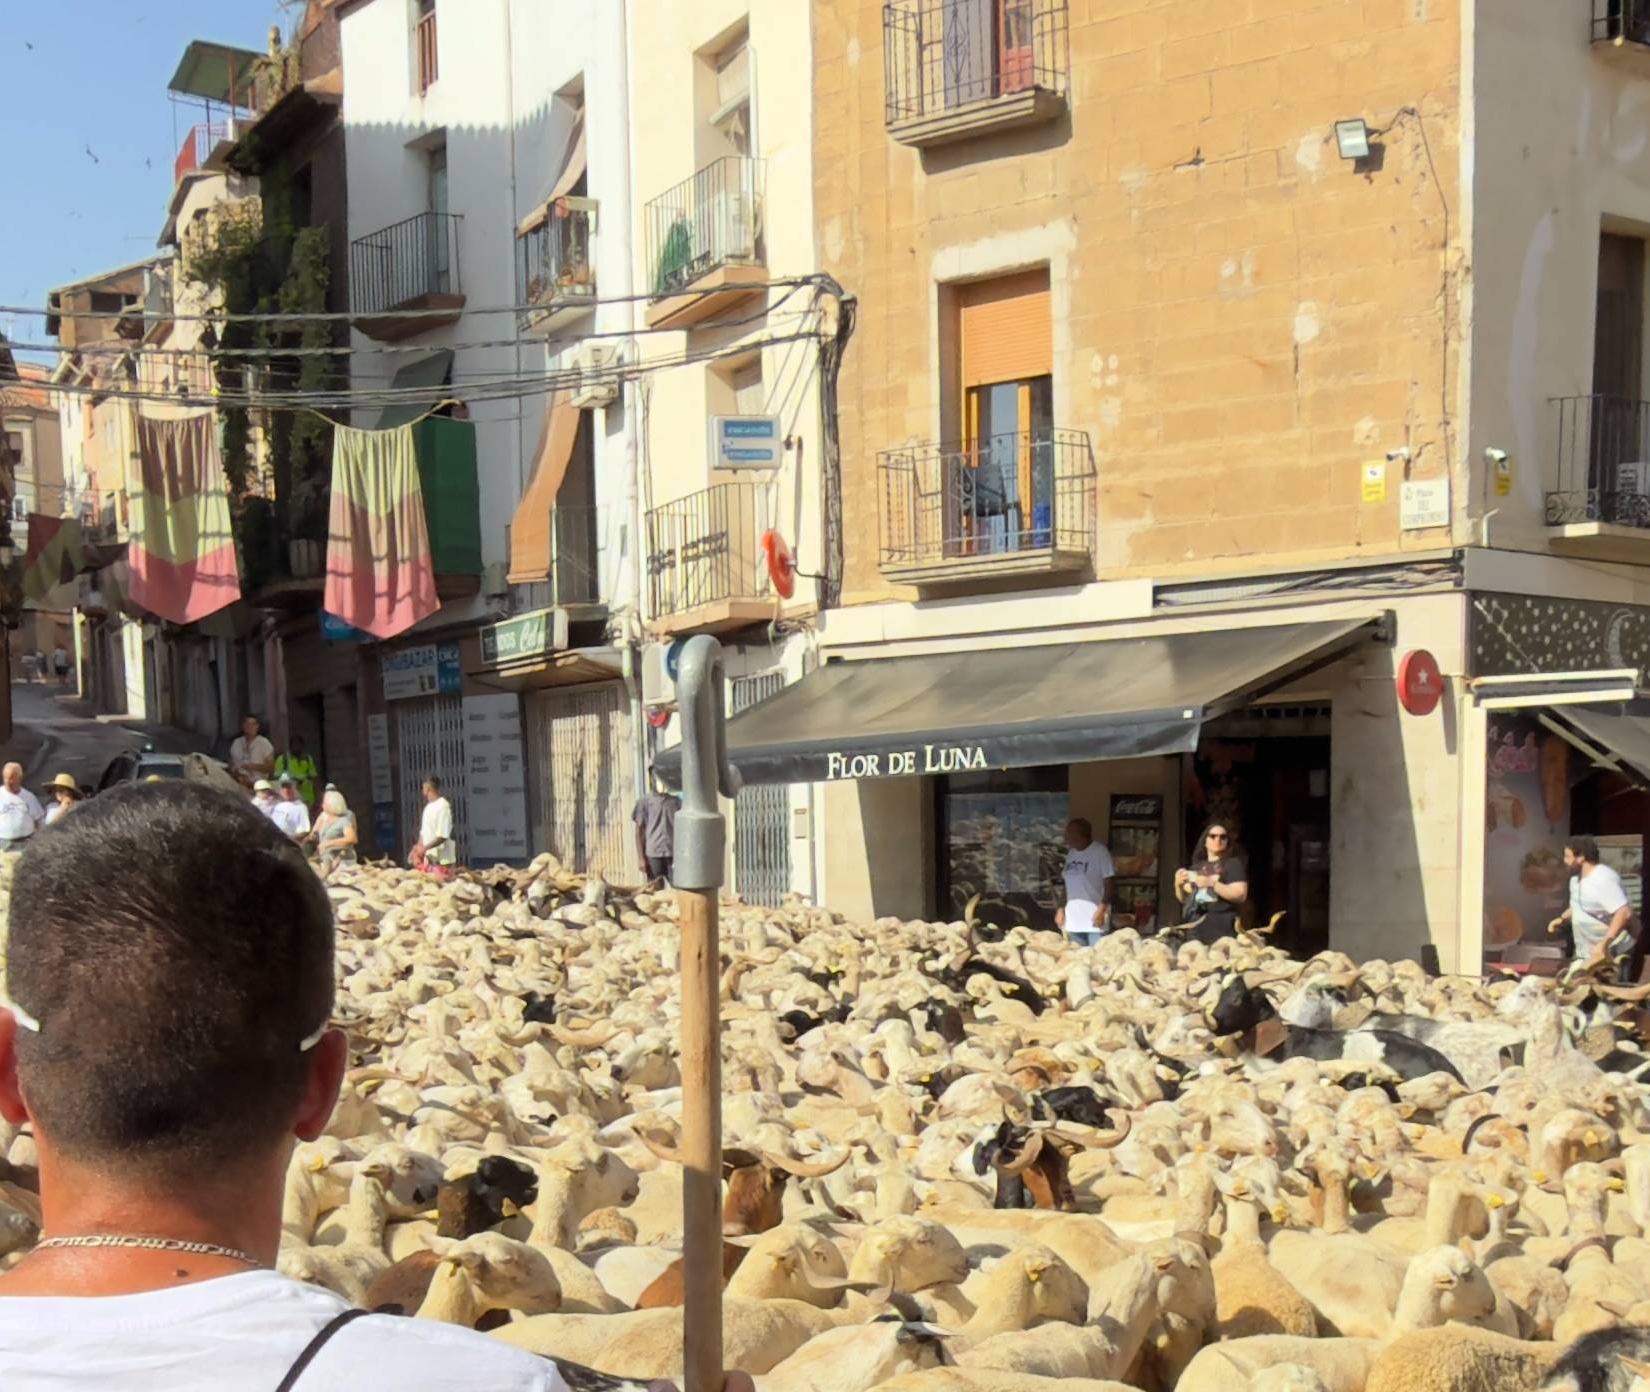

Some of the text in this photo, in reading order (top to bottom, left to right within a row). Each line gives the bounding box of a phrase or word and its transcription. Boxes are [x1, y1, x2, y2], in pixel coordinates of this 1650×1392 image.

[826, 744, 988, 780] FLOR DE LUNA
